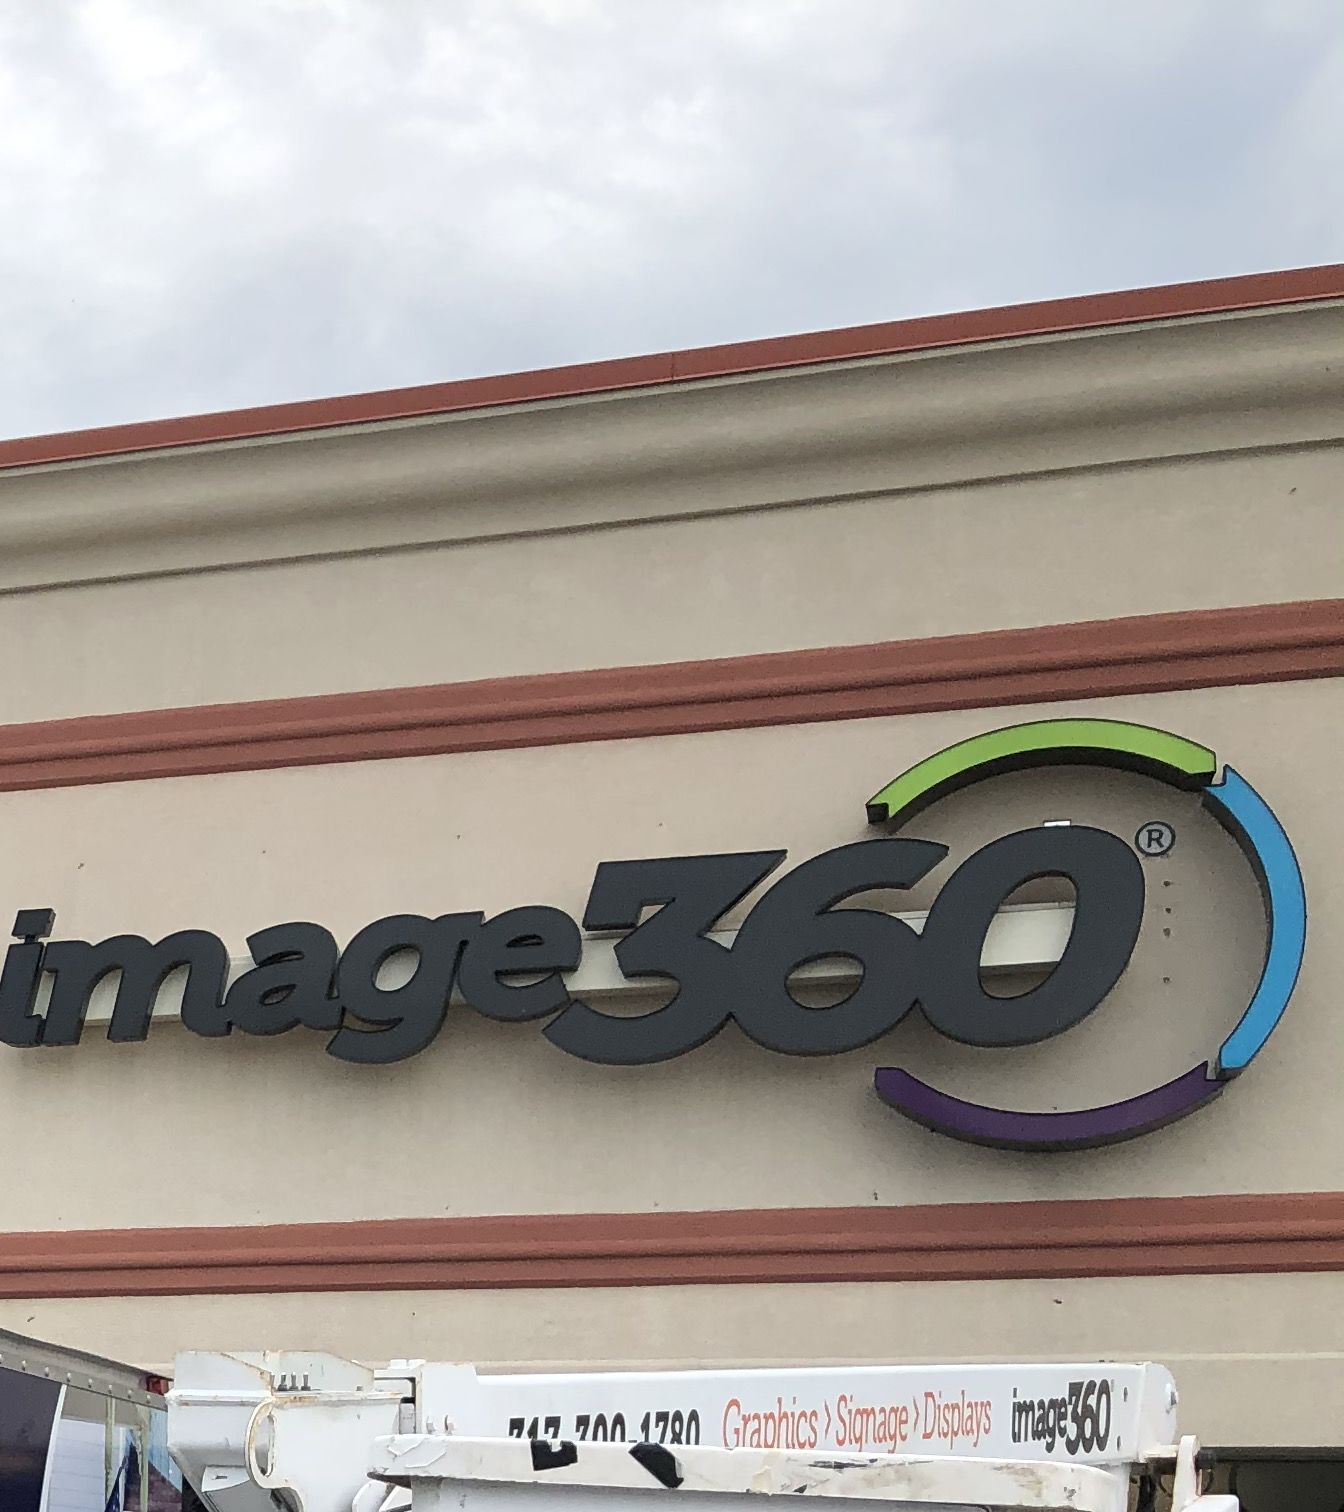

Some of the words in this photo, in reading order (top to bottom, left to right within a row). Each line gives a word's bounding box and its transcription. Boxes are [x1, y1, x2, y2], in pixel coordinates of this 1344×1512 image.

[722, 1396, 818, 1449] Graphics
[836, 1394, 909, 1454] Signage
[922, 1390, 992, 1449] Displays
[1012, 1378, 1112, 1456] image360
